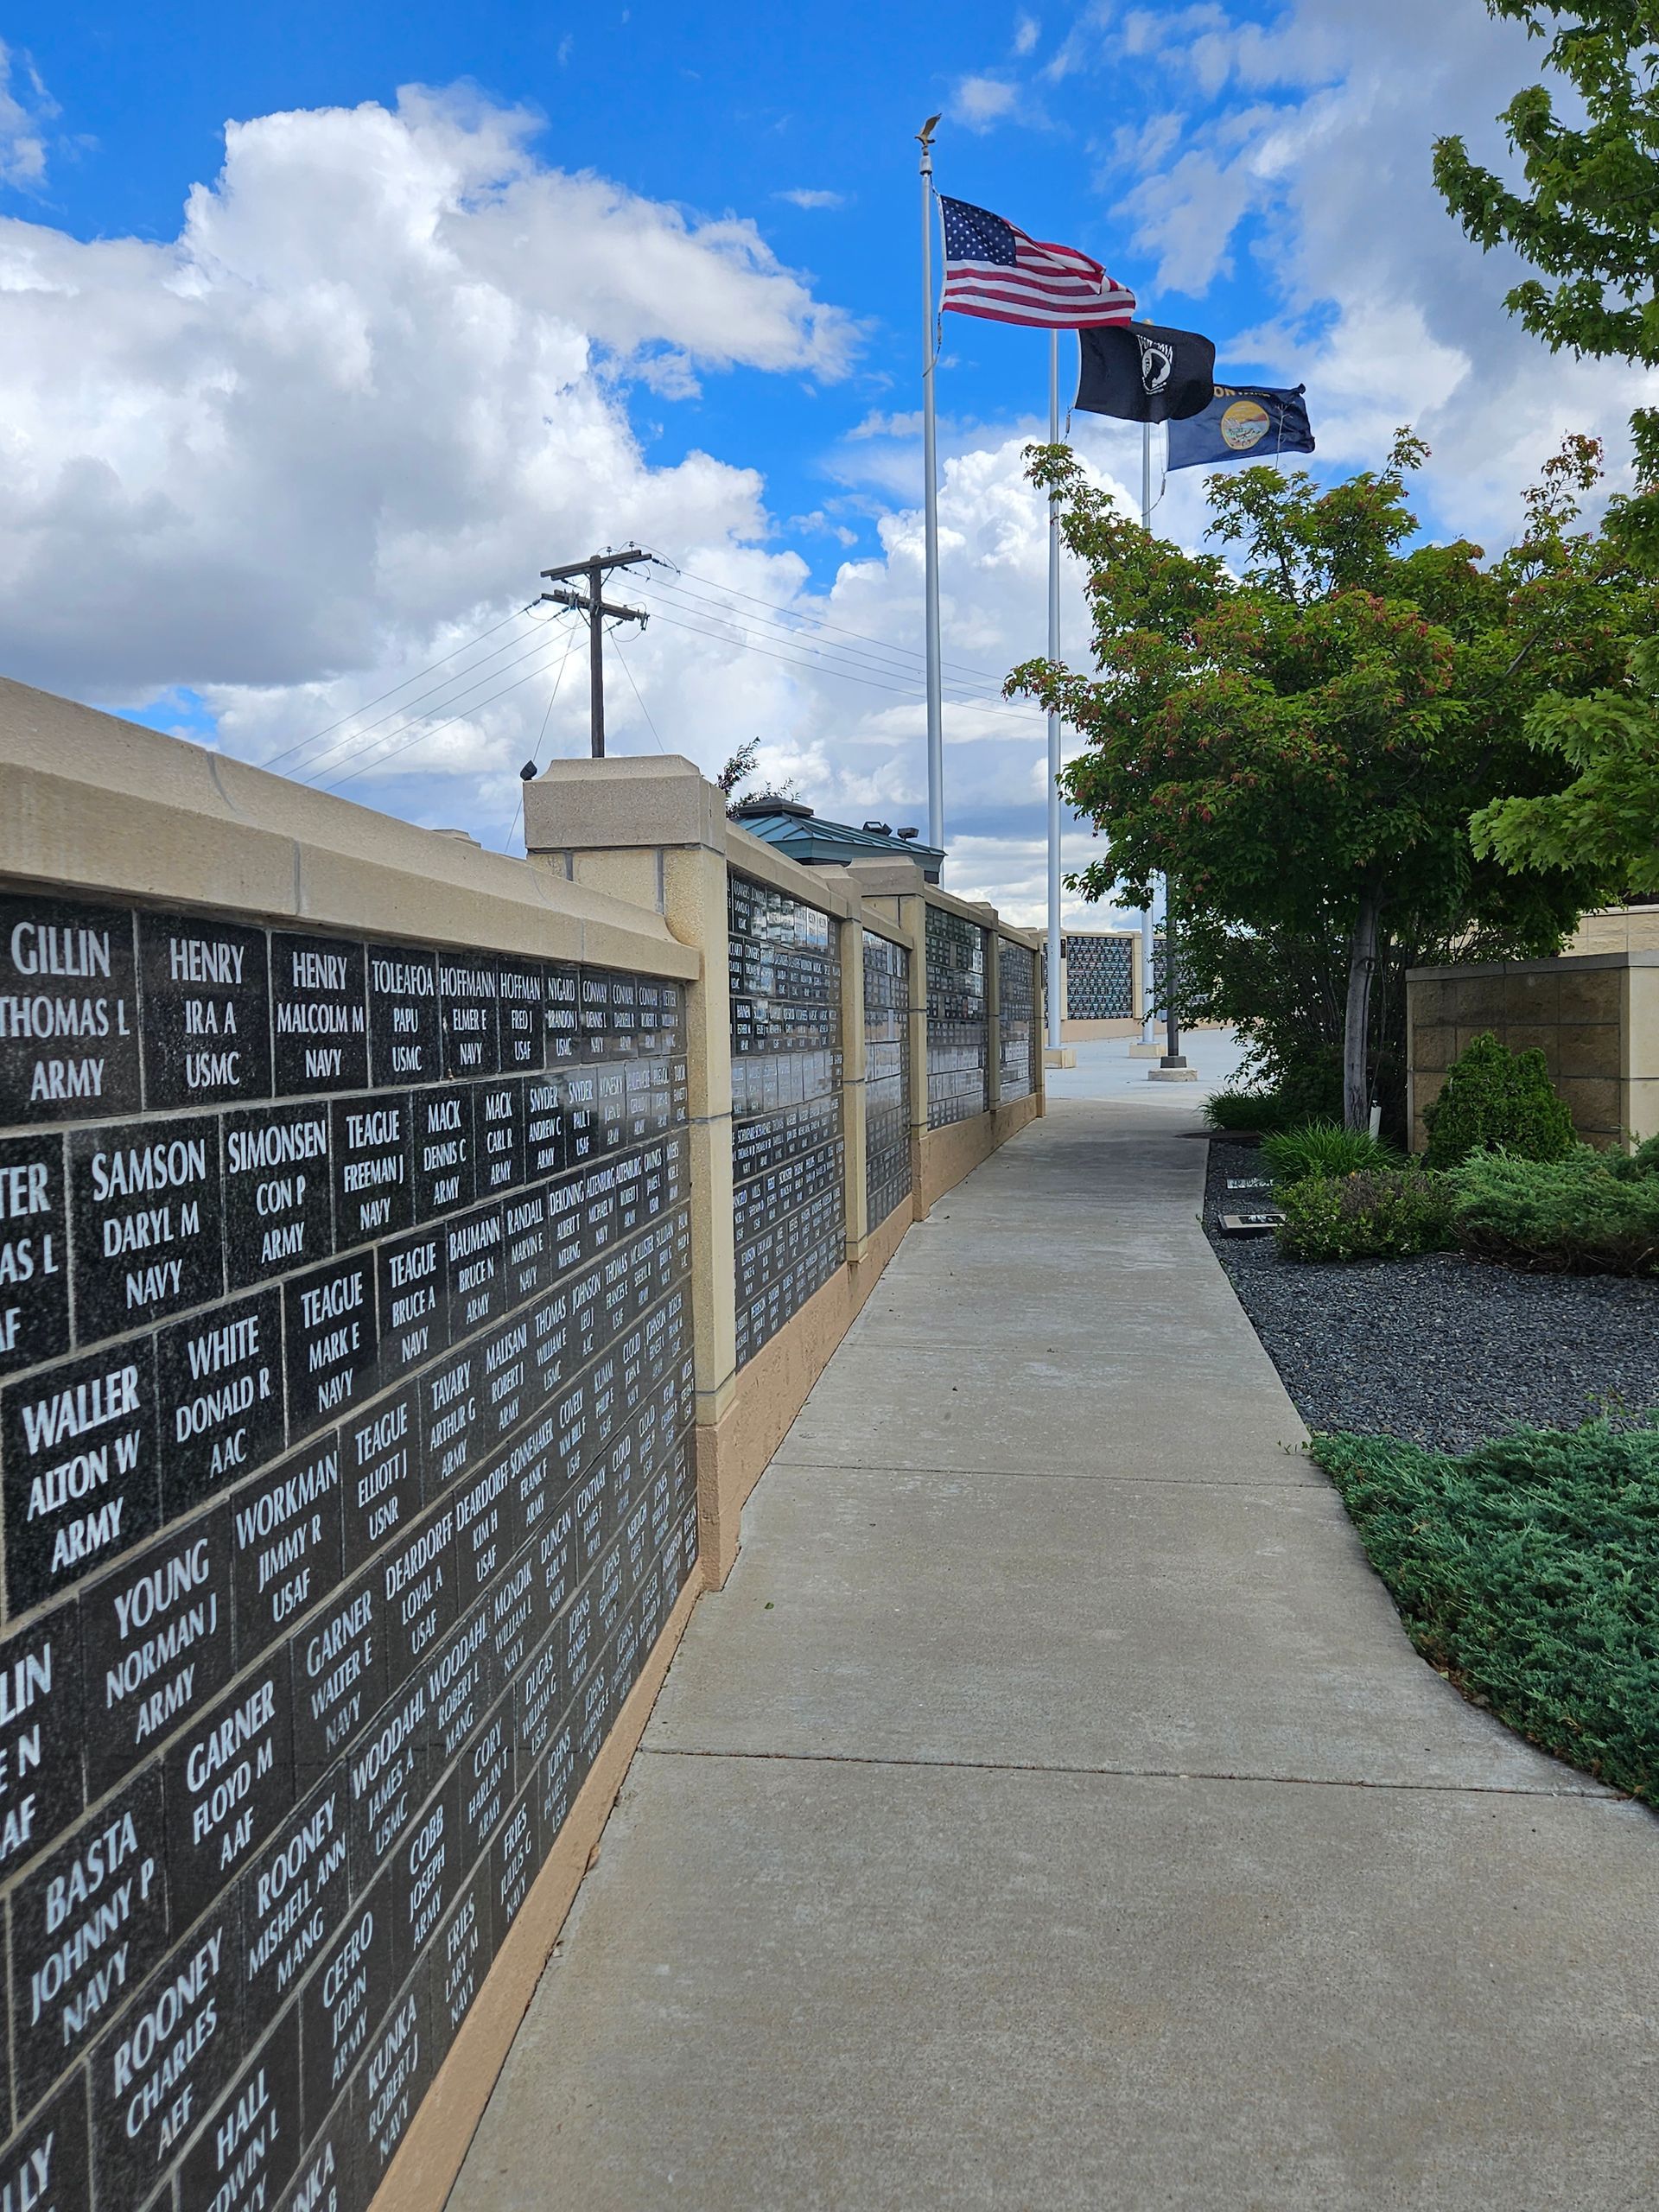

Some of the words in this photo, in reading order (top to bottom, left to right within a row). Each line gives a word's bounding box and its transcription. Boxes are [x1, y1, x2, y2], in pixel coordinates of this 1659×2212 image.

[11, 921, 111, 976] GILLIN
[170, 938, 244, 984] HENRY
[292, 951, 347, 990] HENRY
[372, 960, 434, 995] TOLEAFOA
[441, 968, 495, 997] HOFFMANN
[501, 972, 540, 1000] HOFFMAN
[548, 976, 575, 1001] NYGARD
[0, 995, 109, 1038] THOMAS
[118, 999, 130, 1035] L
[186, 1000, 217, 1034] IRA
[223, 1001, 237, 1034] A
[277, 1002, 347, 1033] MALCOLM
[352, 1006, 365, 1033] M
[394, 1007, 418, 1033] PAPU
[453, 1008, 480, 1031] ELMER
[512, 1010, 528, 1029] FRED
[186, 1052, 240, 1089] USMC
[306, 1049, 342, 1078] NAVY
[392, 1046, 422, 1071] USMC
[460, 1042, 482, 1065] NAVY
[515, 1040, 531, 1060] USAF
[556, 1038, 571, 1056] USMC
[30, 1058, 104, 1101] ARMY
[530, 1085, 559, 1113] SNYDER
[569, 1079, 594, 1104] SNYDER
[346, 1109, 400, 1149] TEAGUE
[428, 1100, 461, 1134] MACK
[486, 1091, 512, 1122] MACK
[529, 1117, 556, 1142] ANDREW
[573, 1111, 586, 1130] PAUL
[227, 1120, 327, 1173] SIMONSEN
[423, 1141, 457, 1172] DENNIS
[486, 1129, 506, 1154] CARL
[537, 1147, 555, 1170] ARMY
[576, 1136, 589, 1156] USAF
[92, 1139, 206, 1201] SAMSON
[344, 1155, 397, 1193] FREEMAN
[433, 1175, 460, 1205] ARMY
[491, 1160, 512, 1185] ARMY
[257, 1178, 292, 1216] CON
[359, 1197, 391, 1231] NAVY
[507, 1198, 543, 1236] RANDALL
[550, 1180, 584, 1216] DEKONING
[103, 1206, 174, 1257] DARYL
[181, 1200, 200, 1237] M
[261, 1222, 305, 1264] ARMY
[449, 1216, 500, 1262] BAUMANN
[512, 1234, 537, 1265] MARVIN
[557, 1216, 575, 1242] ALBERT
[126, 1258, 182, 1309] NAVY
[390, 1242, 436, 1288] TEAGUE
[459, 1261, 486, 1293] BRUCE
[520, 1265, 537, 1293] NAVY
[301, 1271, 363, 1329] TEAGUE
[392, 1289, 425, 1328] BRUCE
[467, 1293, 489, 1325] ARMY
[535, 1295, 566, 1338] THOMAS
[572, 1272, 601, 1316] JOHNSON
[188, 1315, 259, 1380] WHITE
[309, 1326, 349, 1373] MARK
[402, 1325, 429, 1363] NAVY
[486, 1323, 527, 1375] MALISANI
[537, 1332, 563, 1367] WILLIAM
[176, 1376, 254, 1443] DONALD
[318, 1368, 353, 1413] NAVY
[431, 1360, 471, 1411] TAVARY
[492, 1364, 519, 1404] ROBERT
[22, 1364, 141, 1456] WALLER
[355, 1402, 408, 1466] TEAGUE
[429, 1405, 467, 1452] ARTHUR
[27, 1445, 108, 1522] ALTON
[115, 1429, 141, 1474] W
[210, 1428, 247, 1479] AAC
[441, 1439, 467, 1480] ARMY
[236, 1450, 338, 1550] WORKMAN
[358, 1453, 400, 1509] ELLIOTT
[456, 1459, 509, 1532] DEARDORFF
[520, 1462, 543, 1502] FRANK
[369, 1496, 399, 1541] USNR
[473, 1517, 489, 1551] KIM
[526, 1490, 545, 1528] ARMY
[51, 1497, 124, 1573] ARMY
[258, 1522, 307, 1594] JIMMY
[386, 1511, 453, 1600] DEARDORFF
[541, 1507, 571, 1565] DUNCAN
[114, 1538, 209, 1640] YOUNG
[477, 1544, 497, 1583] USAF
[272, 1567, 310, 1623] USAF
[402, 1575, 433, 1625] LOYAL
[494, 1558, 532, 1624] MONDIK
[307, 1589, 372, 1677] GARNER
[411, 1608, 436, 1655] USAF
[495, 1601, 526, 1654] WILLIAM
[106, 1602, 205, 1709] NORMAN
[429, 1612, 487, 1702] WOODAHL
[504, 1635, 524, 1676] NAVY
[525, 1644, 553, 1706] DUGAS
[136, 1662, 195, 1745] ARMY
[311, 1649, 361, 1721] WALTER
[438, 1668, 473, 1730] ROBERT
[187, 1680, 276, 1793] GARNER
[326, 1691, 361, 1754] NAVY
[353, 1687, 426, 1800] WOODAHL
[445, 1701, 474, 1758] MANG
[474, 1717, 502, 1778] CORY
[193, 1760, 251, 1846] FLOYD
[369, 1759, 402, 1832] JAMES
[468, 1758, 501, 1825] HARLAN
[219, 1806, 254, 1871] AAF
[375, 1791, 408, 1856] USMC
[410, 1803, 444, 1875] COBB
[478, 1790, 501, 1846] ARMY
[505, 1802, 527, 1860] FRIES
[46, 1810, 138, 1936] BASTA
[258, 1792, 335, 1918] ROONEY
[500, 1844, 524, 1906] JULIUS
[249, 1878, 312, 1981] MISHELL
[316, 1831, 346, 1893] ANN
[410, 1842, 445, 1923] JOSEPH
[506, 1872, 526, 1923] NAVY
[413, 1885, 442, 1951] ARMY
[448, 1891, 475, 1962] FRIES
[31, 1877, 132, 2027] JOHNNY
[277, 1906, 324, 1993] MANG
[323, 1910, 372, 2009] CEFRO
[446, 1945, 467, 2004] LARY
[63, 1941, 129, 2047] NAVY
[114, 1927, 222, 2100] ROONEY
[333, 1966, 366, 2049] JOHN
[451, 1968, 474, 2030] NAVY
[126, 1997, 216, 2139] CHARLES
[332, 2006, 367, 2089] ARMY
[368, 1993, 416, 2100] KUNKA
[217, 2067, 270, 2172] HALL
[369, 2045, 411, 2143] ROBERT
[380, 2089, 409, 2165] NAVY
